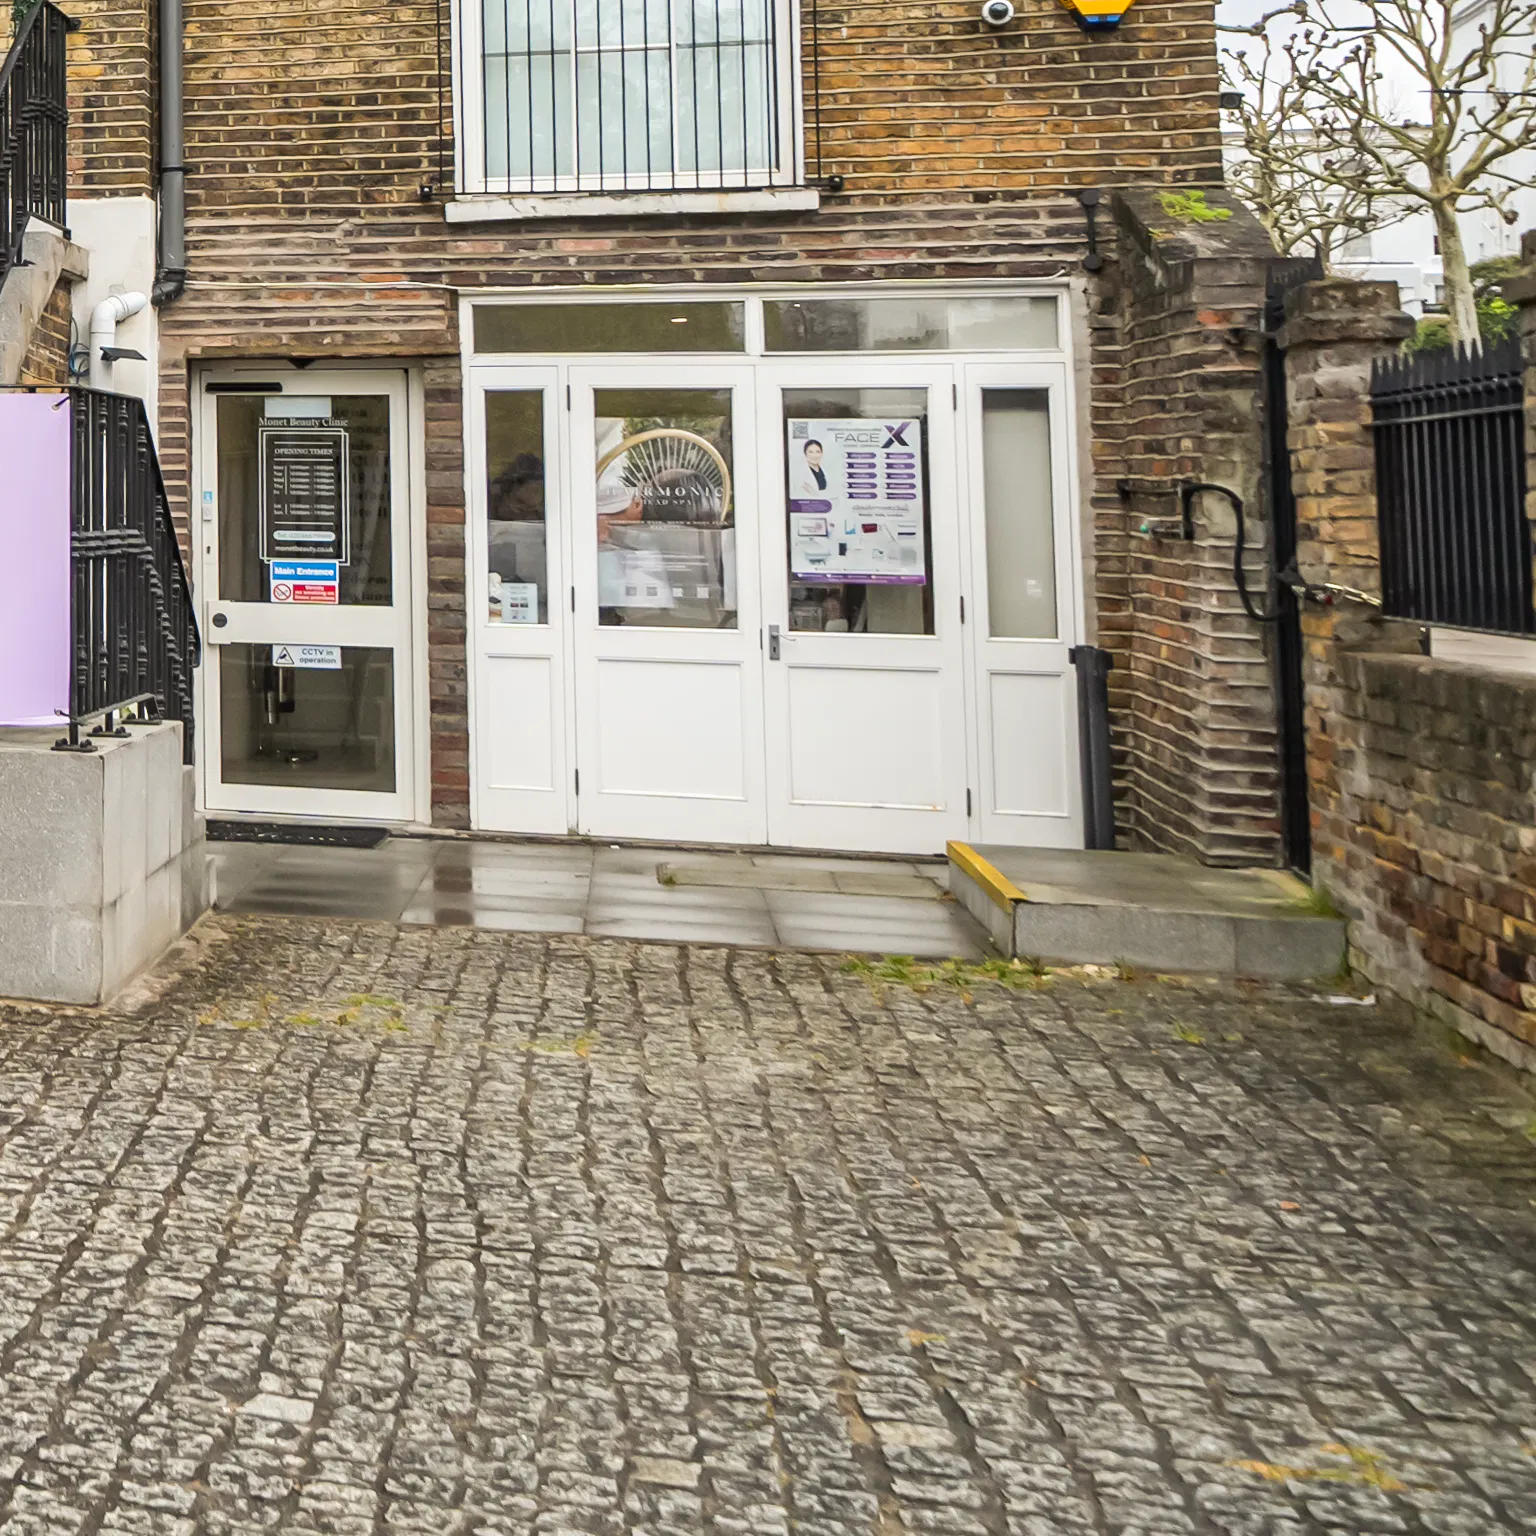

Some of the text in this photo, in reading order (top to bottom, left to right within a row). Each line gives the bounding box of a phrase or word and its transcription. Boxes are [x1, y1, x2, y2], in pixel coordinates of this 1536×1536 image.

[259, 417, 348, 428] Monet Beauty Clinic
[835, 433, 879, 443] FACE
[309, 448, 333, 456] TIMES
[274, 567, 334, 576] Main Entrance
